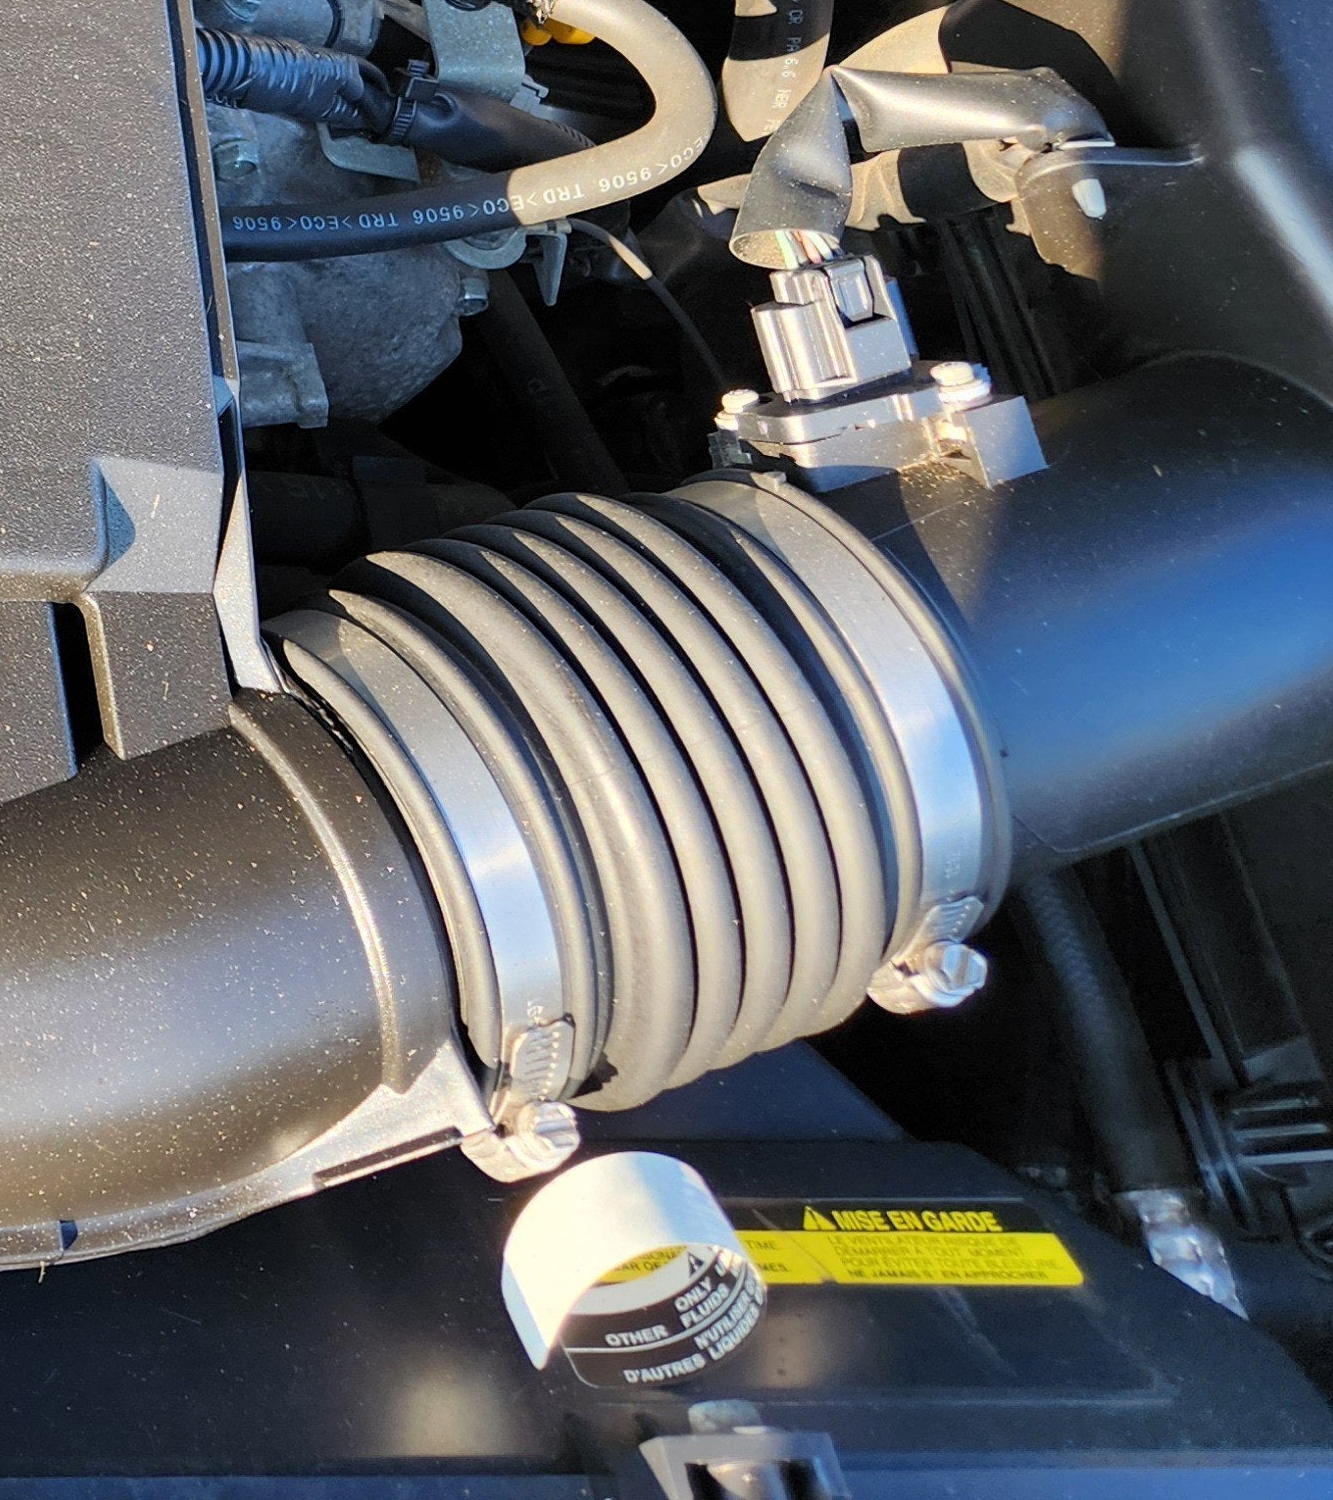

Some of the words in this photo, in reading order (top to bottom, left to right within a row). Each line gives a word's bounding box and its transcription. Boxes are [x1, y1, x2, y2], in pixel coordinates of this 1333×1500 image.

[831, 1209, 890, 1231] MISE
[886, 1210, 924, 1231] EN
[921, 1210, 1003, 1232] GARDE
[674, 1276, 713, 1313] ONLY
[604, 1324, 670, 1347] OTHER
[679, 1283, 730, 1329] FLUIDS
[623, 1353, 706, 1384] D'AUTRES
